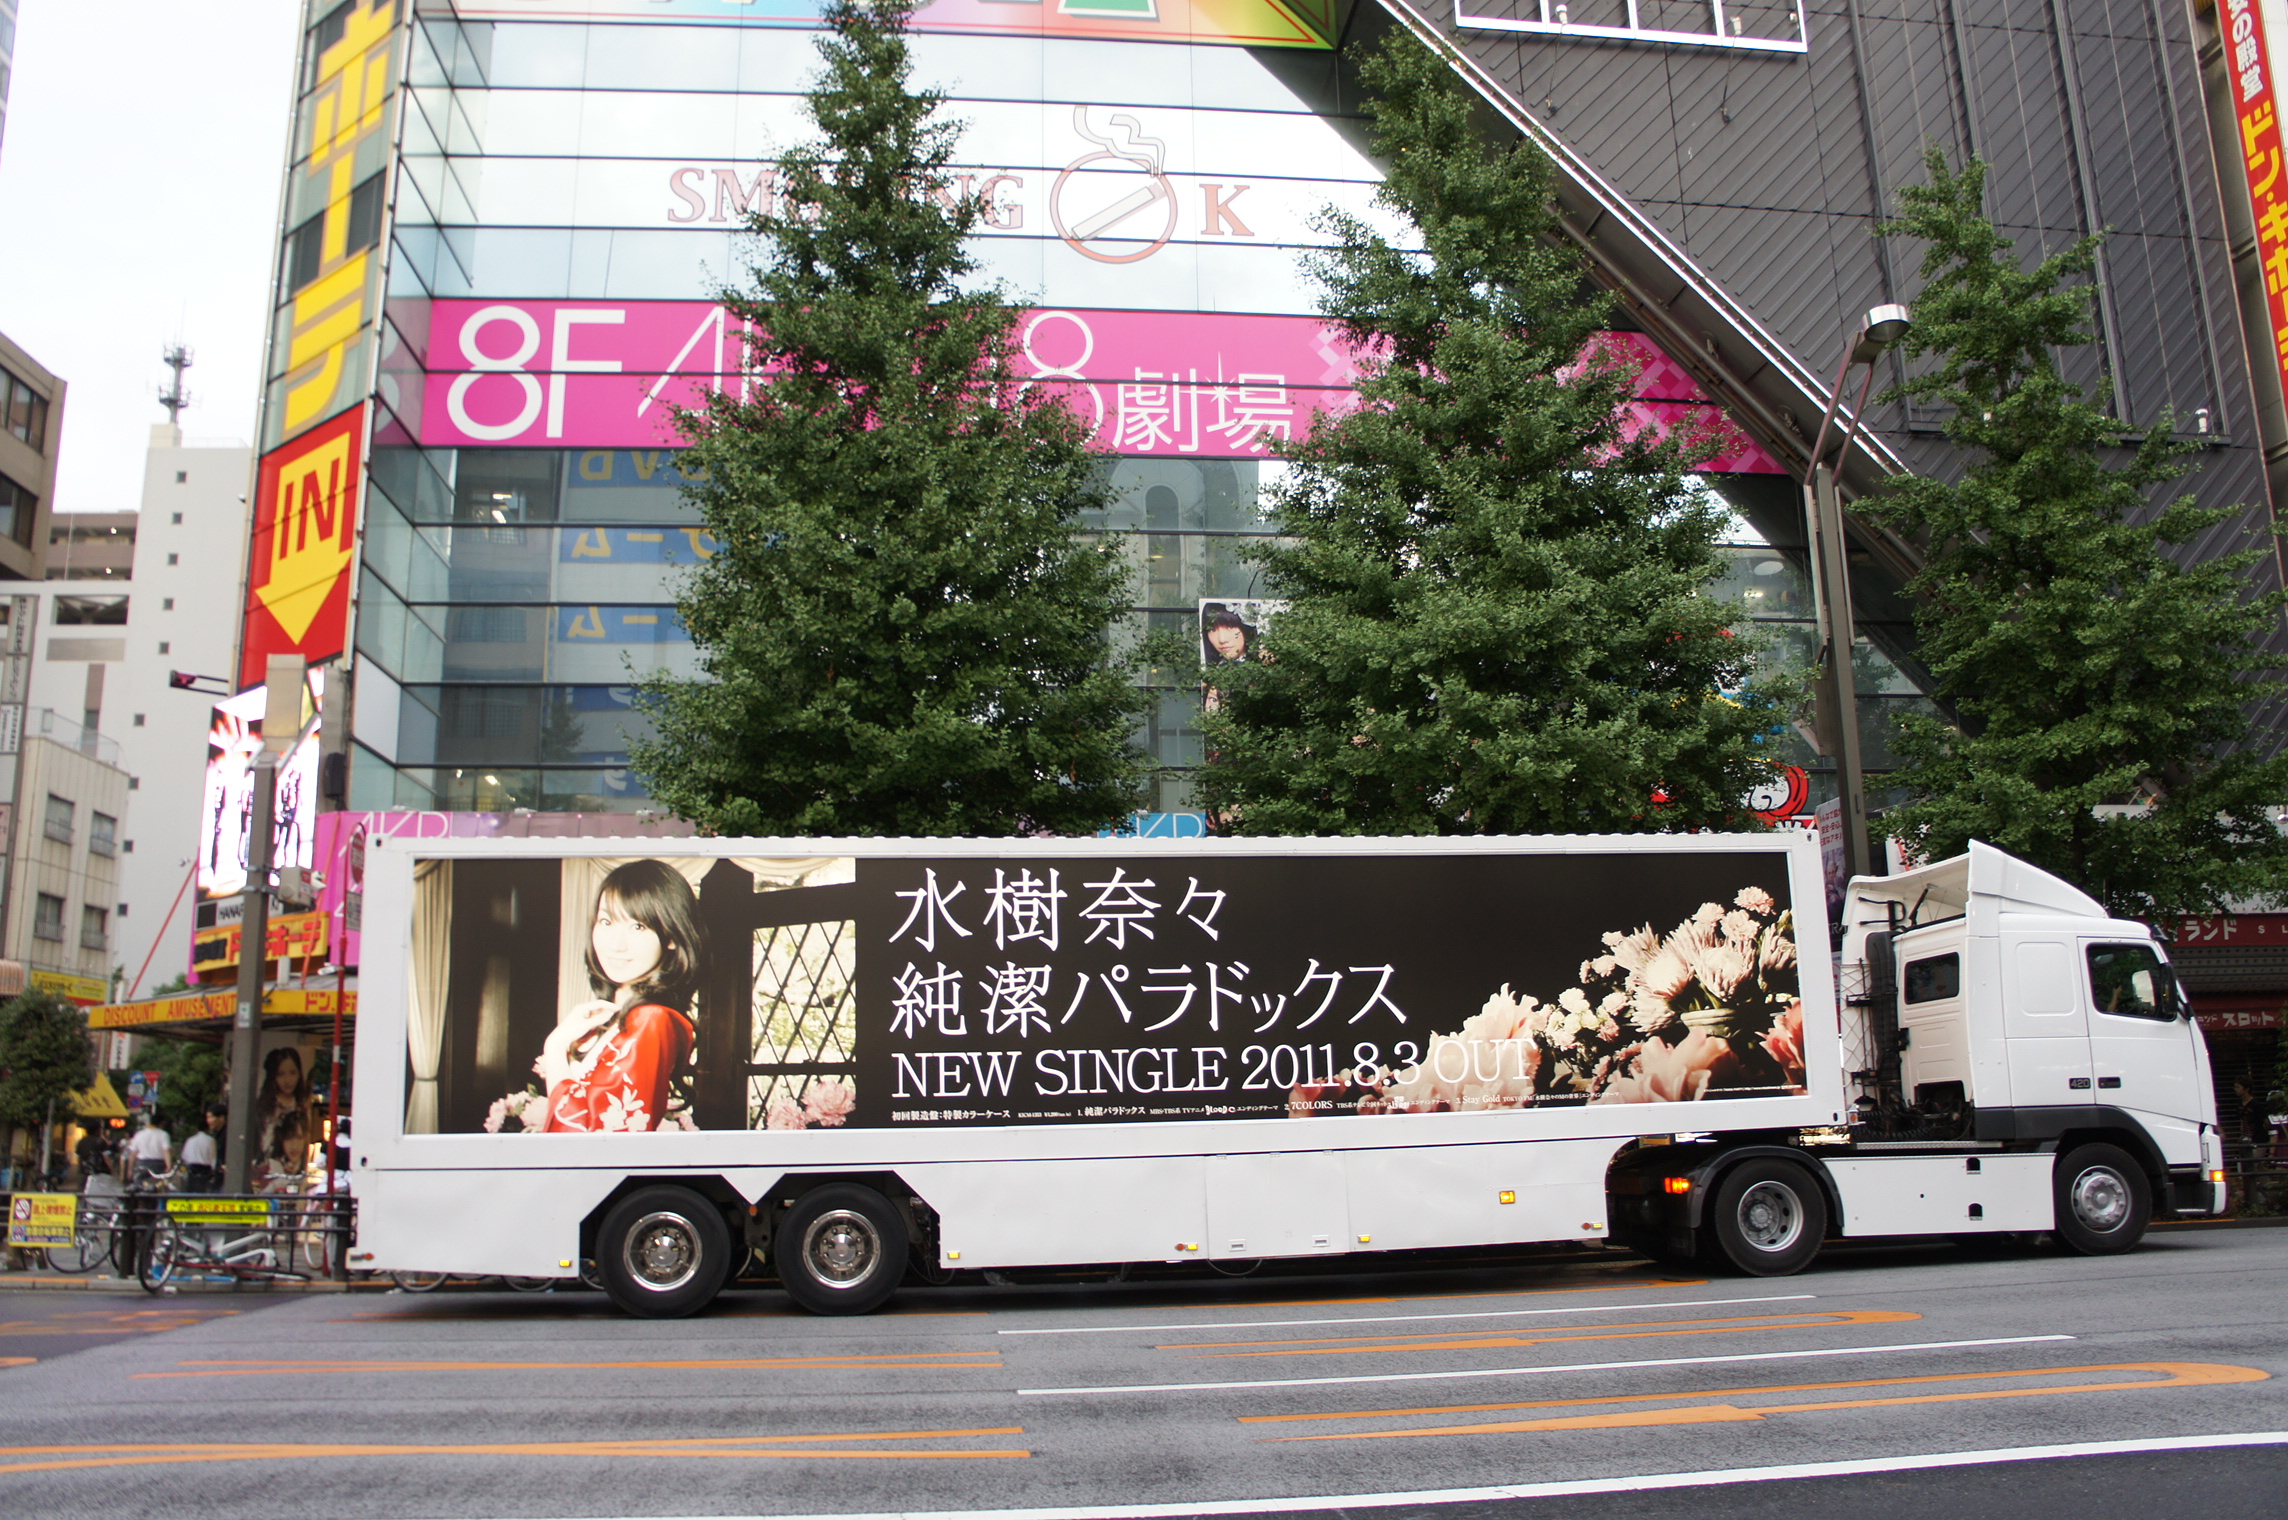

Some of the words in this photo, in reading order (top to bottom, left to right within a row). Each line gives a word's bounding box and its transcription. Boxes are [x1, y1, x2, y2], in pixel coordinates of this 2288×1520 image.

[279, 457, 341, 561] IN
[888, 867, 1226, 952] 水樹奈々
[104, 1003, 157, 1025] DISCOUNT
[889, 958, 1408, 1039] 純潔パラドックス
[891, 1051, 1022, 1097] NEW
[1034, 1046, 1228, 1095] SINGLE
[1240, 1040, 1422, 1090] 2011.8.3
[1433, 1038, 1538, 1084] OUT
[2071, 1078, 2090, 1088] 420
[1291, 1100, 1333, 1111] 7COLORS
[1482, 1094, 1501, 1104] Gold
